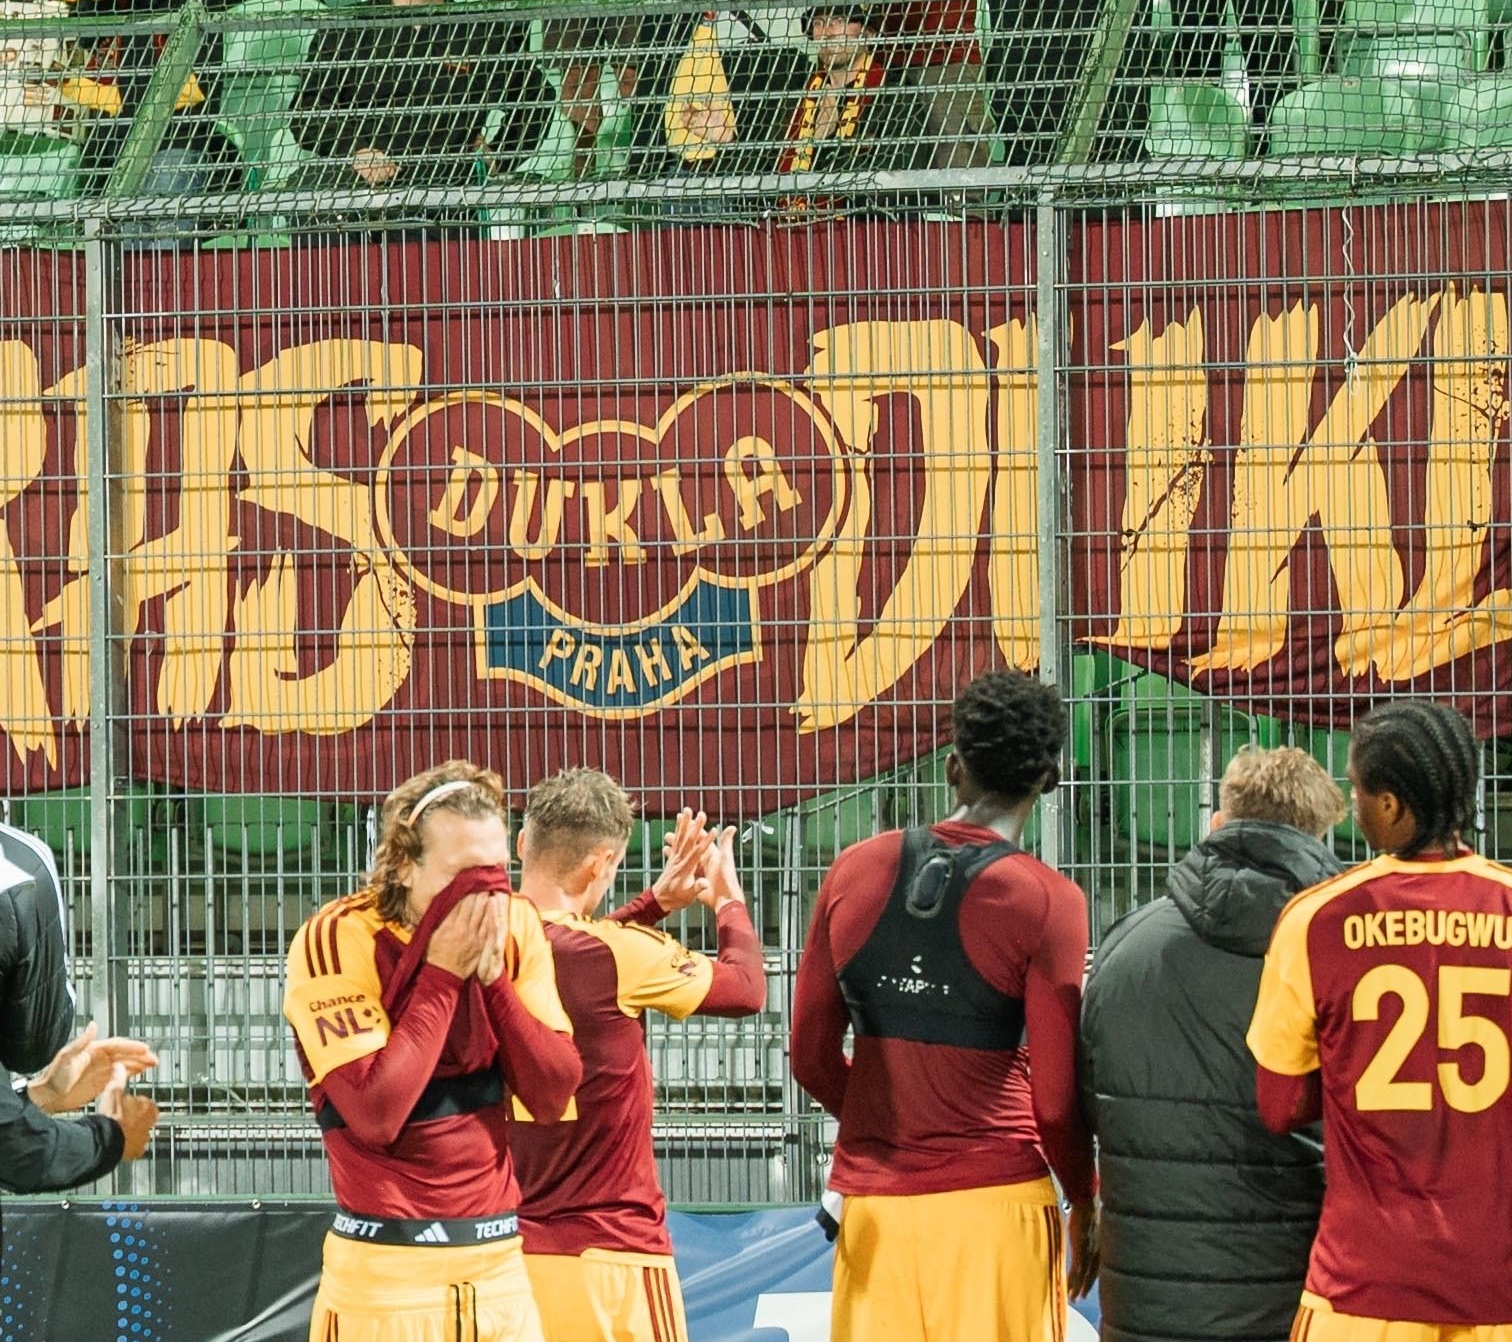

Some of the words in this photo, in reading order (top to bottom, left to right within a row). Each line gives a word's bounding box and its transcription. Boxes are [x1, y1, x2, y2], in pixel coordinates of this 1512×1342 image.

[427, 434, 804, 569] DUKLA
[543, 625, 711, 697] PRAHA
[309, 994, 366, 1013] Chance
[1351, 963, 1512, 1114] 25
